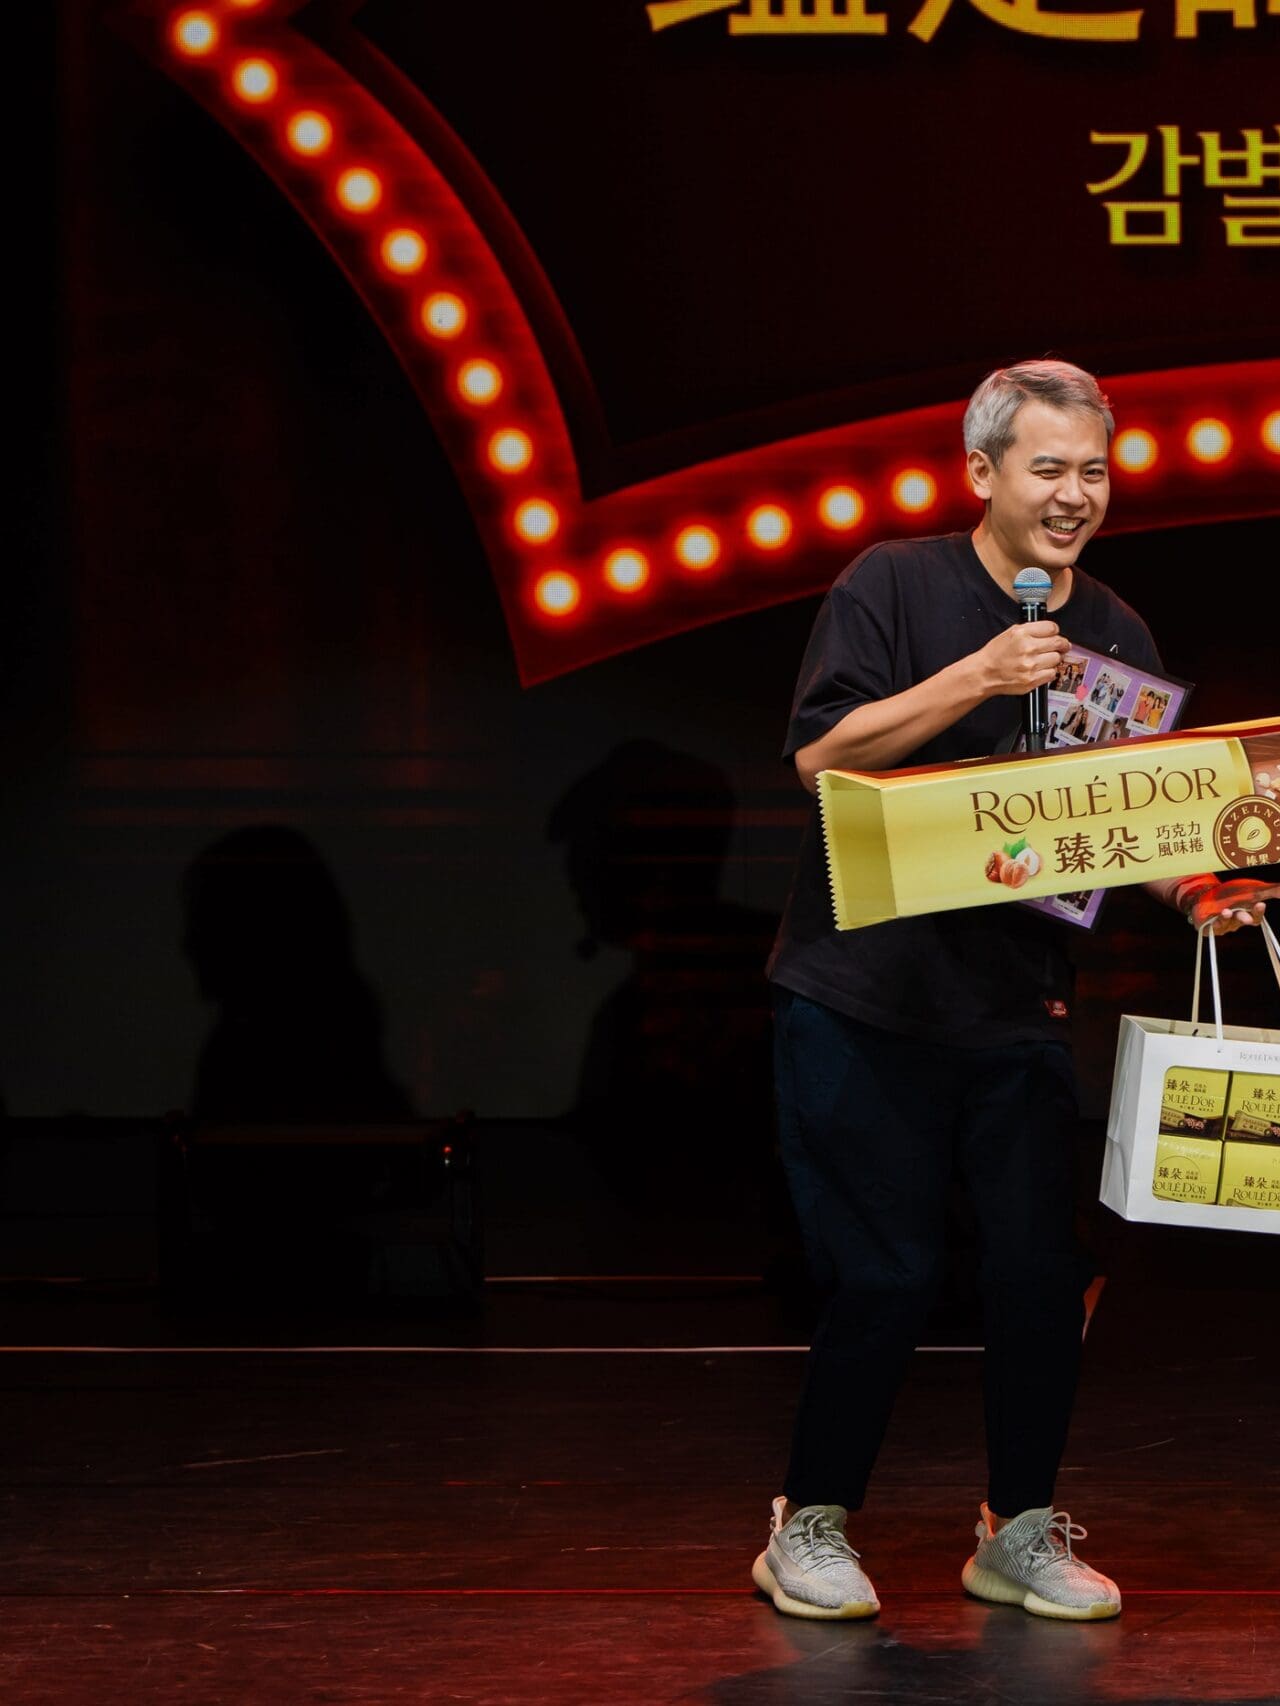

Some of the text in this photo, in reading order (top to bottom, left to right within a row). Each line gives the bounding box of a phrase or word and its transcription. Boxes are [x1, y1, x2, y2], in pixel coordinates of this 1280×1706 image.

[969, 766, 1221, 834] ROULÉ D'OR
[1156, 821, 1201, 840] 巧克力
[1157, 836, 1205, 858] 風味捲
[1053, 826, 1153, 875] 臻朵
